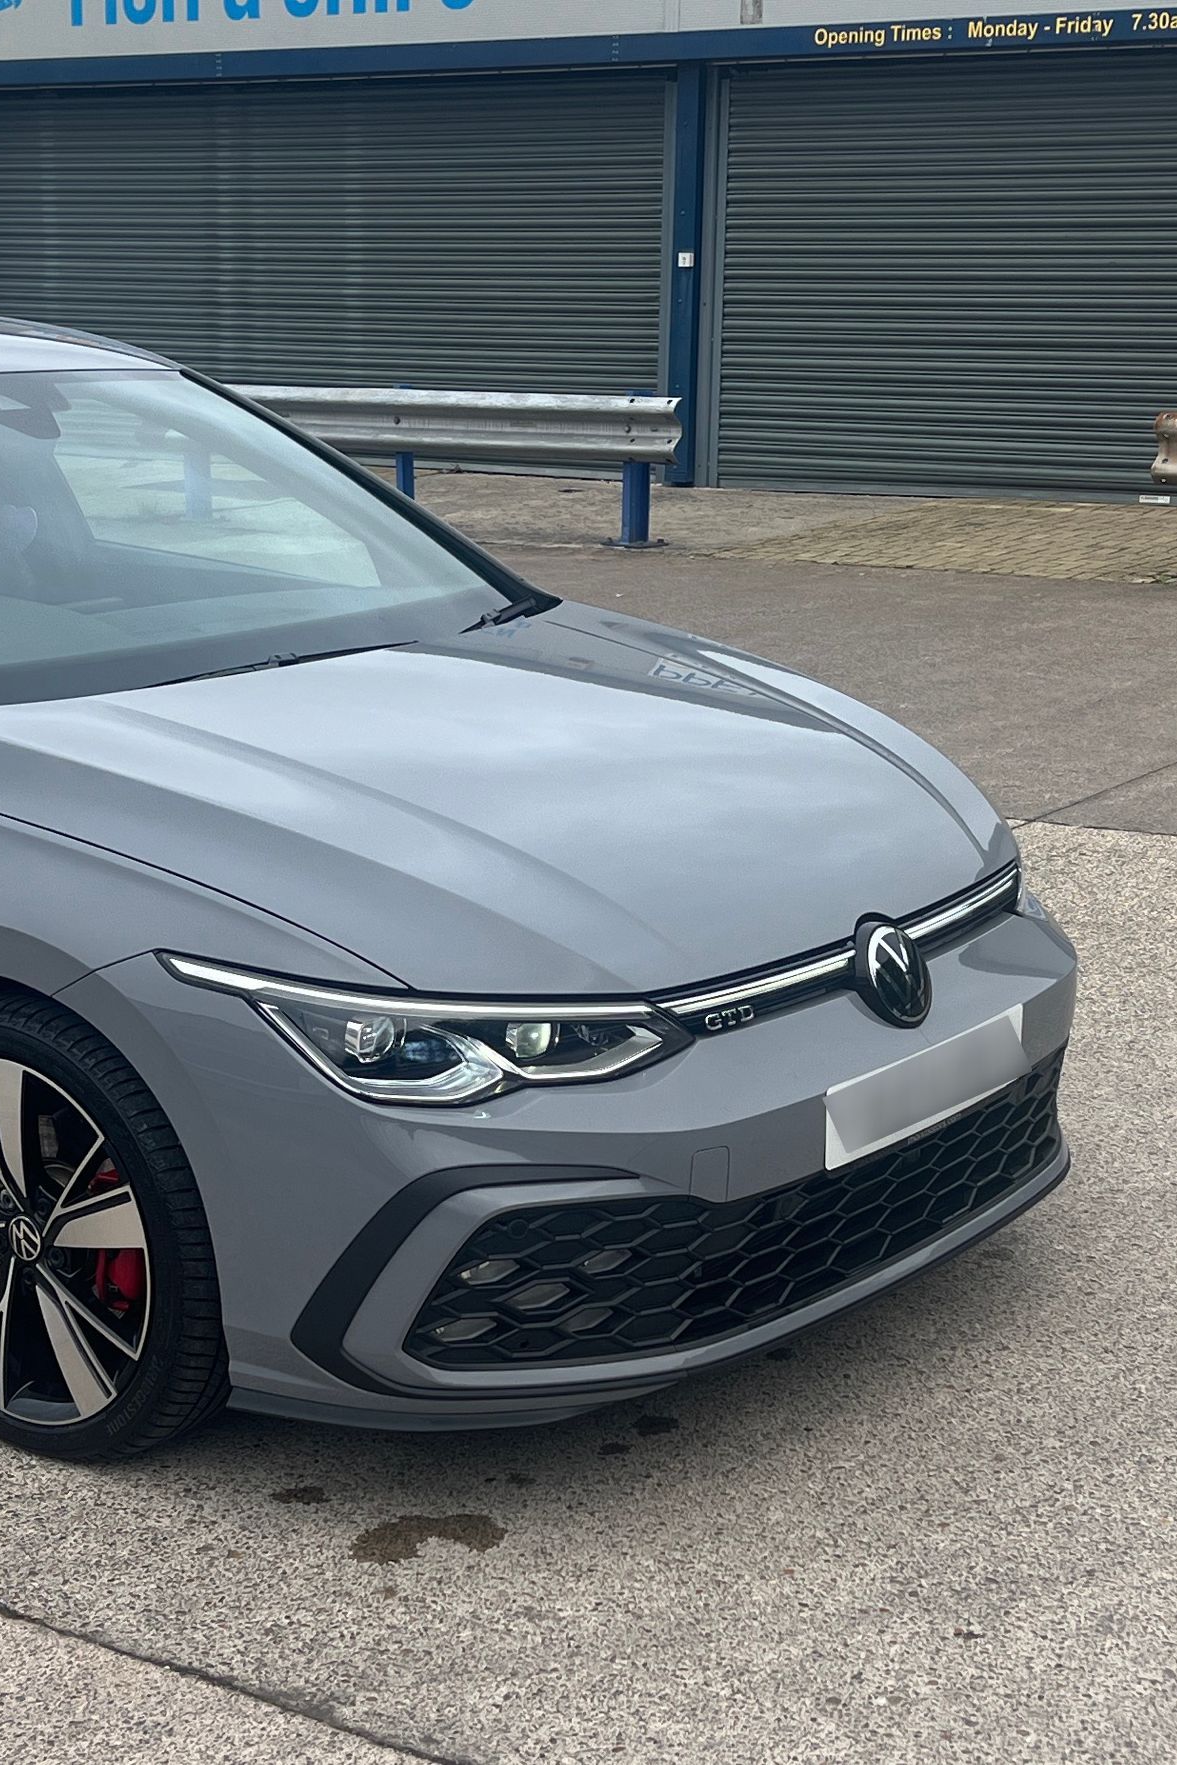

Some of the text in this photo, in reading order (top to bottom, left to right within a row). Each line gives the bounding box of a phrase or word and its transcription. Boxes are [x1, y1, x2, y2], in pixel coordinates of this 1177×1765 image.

[814, 26, 885, 48] Opening
[890, 24, 942, 42] Times
[968, 19, 1038, 40] Monday
[1055, 16, 1114, 38] Friday
[705, 1004, 754, 1031] GTD
